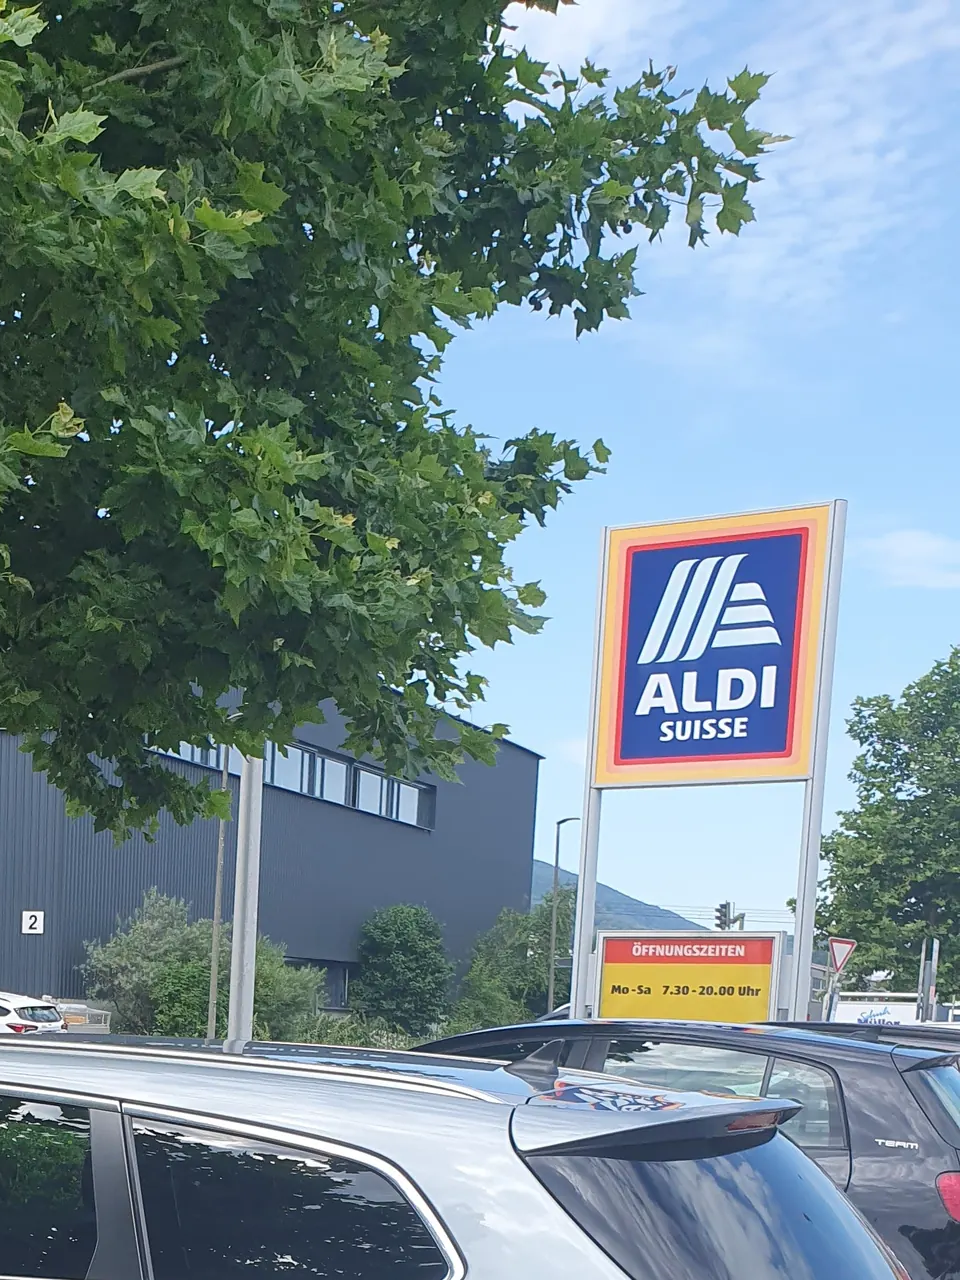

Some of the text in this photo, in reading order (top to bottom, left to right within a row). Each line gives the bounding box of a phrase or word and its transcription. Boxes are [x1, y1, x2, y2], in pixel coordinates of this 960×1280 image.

[634, 664, 778, 716] ALDI
[658, 716, 749, 742] SUISSE
[28, 914, 38, 930] 2
[631, 941, 746, 957] ÖFFNUNGSZEITEN
[738, 985, 761, 996] Uhr
[874, 1138, 919, 1150] TEAM
